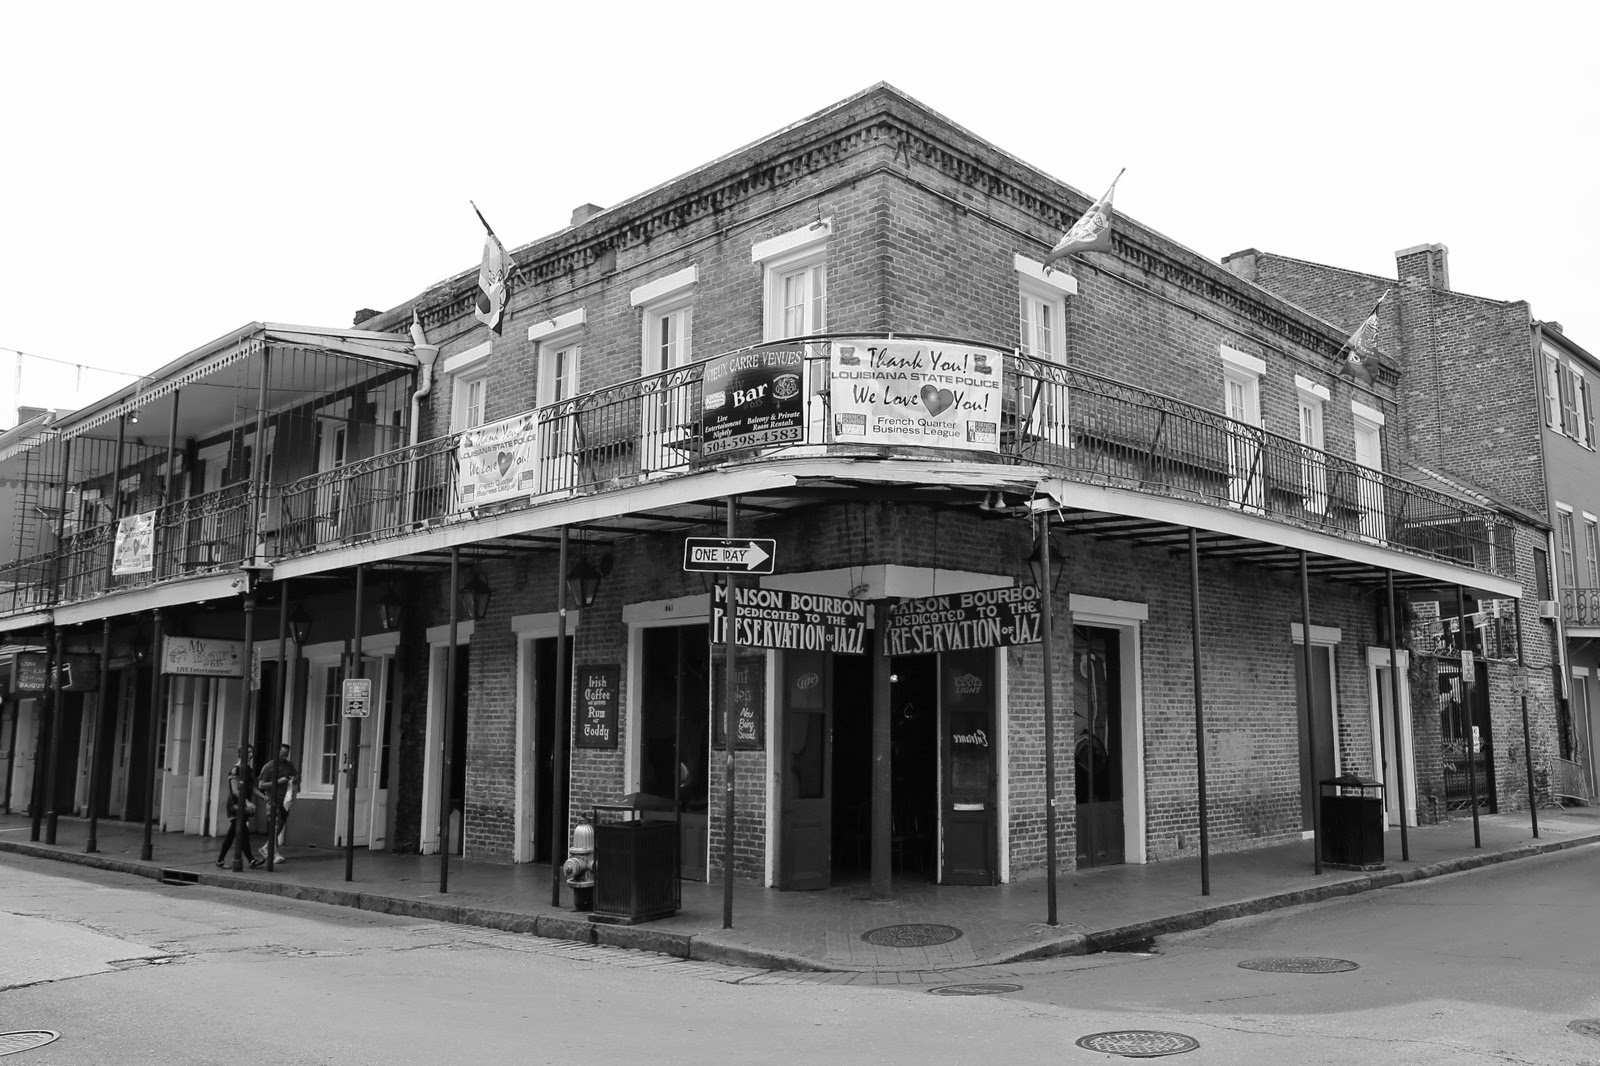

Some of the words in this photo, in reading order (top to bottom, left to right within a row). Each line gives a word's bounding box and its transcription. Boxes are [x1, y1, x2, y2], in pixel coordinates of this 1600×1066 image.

[706, 362, 728, 381] VIEUX
[730, 354, 759, 373] CARRE
[762, 350, 803, 366] VENUES
[867, 347, 924, 369] Thank
[930, 350, 968, 374] You!
[832, 371, 907, 380] LOUISIANA
[910, 372, 953, 384] STATE
[955, 376, 999, 389] POLICE
[733, 383, 768, 408] Bar
[852, 384, 876, 404] We
[883, 385, 919, 406] Love
[953, 390, 989, 412] You!
[705, 419, 742, 433] Entertainment
[717, 415, 728, 423] Live
[747, 416, 770, 425] Balcony
[777, 411, 801, 420] Private
[753, 423, 770, 431] Room
[770, 418, 794, 428] Rentals
[877, 416, 915, 426] French
[917, 418, 957, 429] Quarter
[713, 428, 733, 439] Nightly
[873, 425, 920, 435] Business
[923, 428, 961, 438] League
[492, 440, 513, 452] STATE
[513, 434, 536, 446] POLICE
[706, 428, 798, 453] 504-598-4583
[469, 461, 479, 477] We
[481, 458, 497, 475] Love
[512, 445, 531, 467] You!
[695, 548, 718, 561] ONE
[714, 585, 783, 609] MAISON
[790, 594, 865, 617] BOURBON
[736, 606, 800, 621] DEDICATED
[805, 613, 820, 624] TO
[826, 615, 847, 626] THE
[895, 609, 966, 627] DEDICATED
[976, 605, 998, 618] TO
[1008, 600, 1038, 615] THE
[1001, 626, 1014, 635] OF
[1010, 613, 1043, 645] JAZ
[188, 639, 207, 652] My
[825, 633, 835, 642] OF
[831, 622, 865, 654] JAZZ
[210, 659, 224, 668] 635
[588, 675, 607, 688] Irish
[584, 688, 611, 700] Coffee
[587, 706, 606, 718] Rum
[584, 723, 610, 741] Toddy
[738, 717, 755, 733] Being
